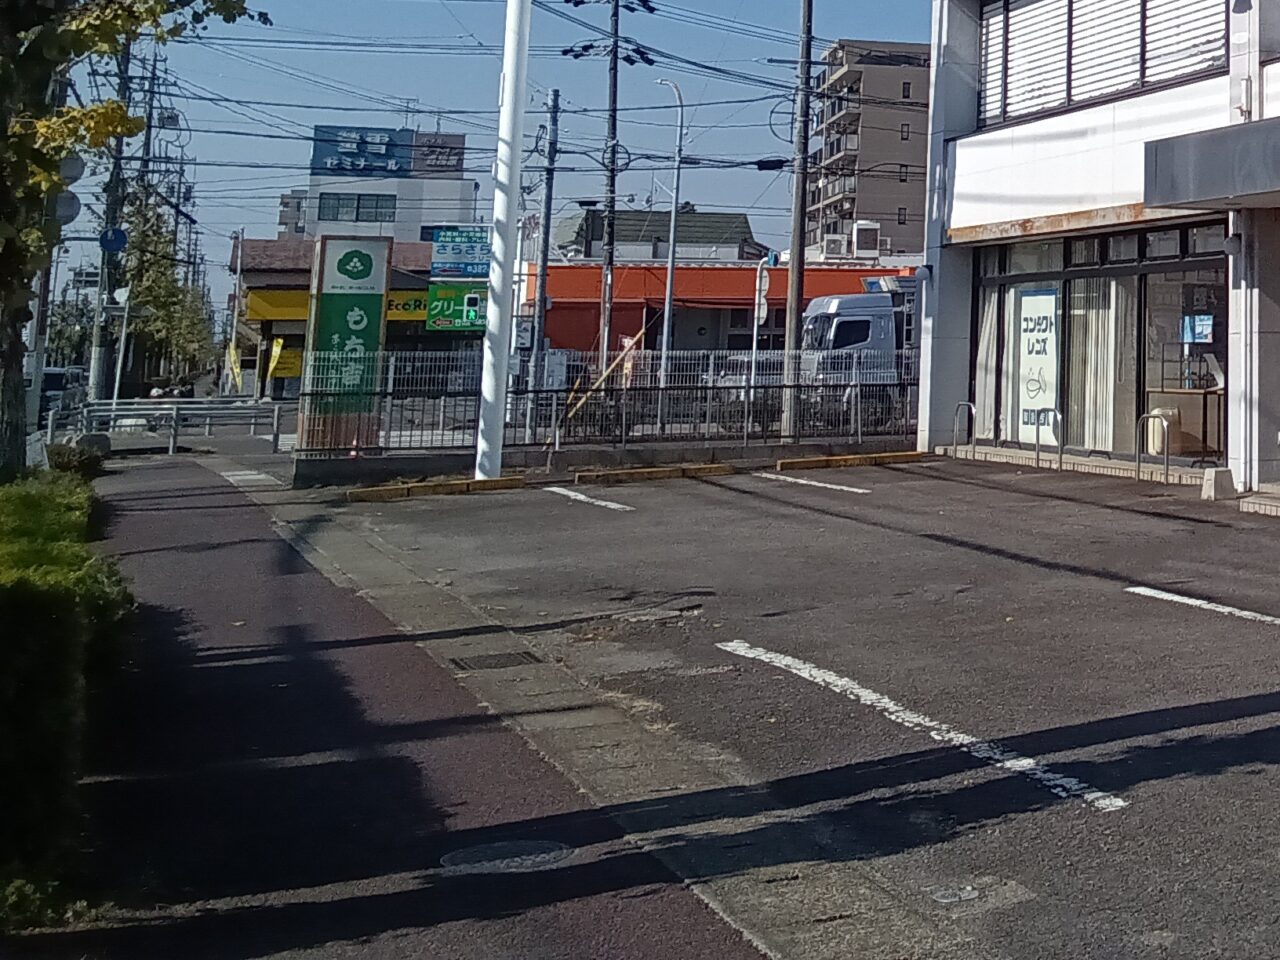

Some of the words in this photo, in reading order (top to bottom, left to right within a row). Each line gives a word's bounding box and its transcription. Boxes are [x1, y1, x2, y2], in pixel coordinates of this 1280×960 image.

[1022, 315, 1053, 333] コンタクト
[1027, 337, 1048, 356] レンズ
